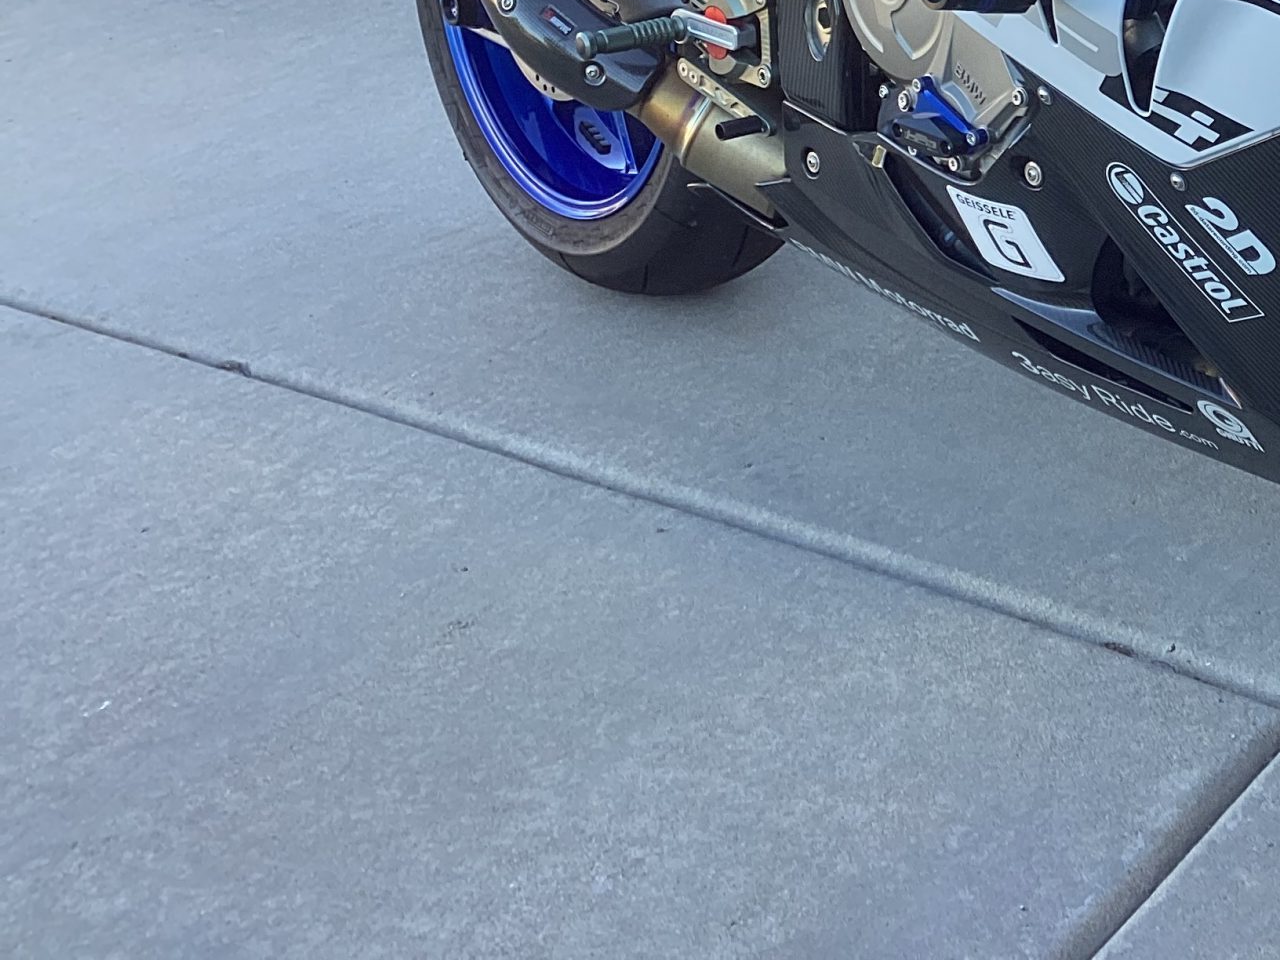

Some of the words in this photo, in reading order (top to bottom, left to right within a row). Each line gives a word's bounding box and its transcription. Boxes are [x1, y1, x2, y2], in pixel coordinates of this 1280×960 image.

[956, 193, 1016, 221] GEISSELE
[1185, 196, 1277, 276] 2D
[1137, 204, 1249, 315] Castrol
